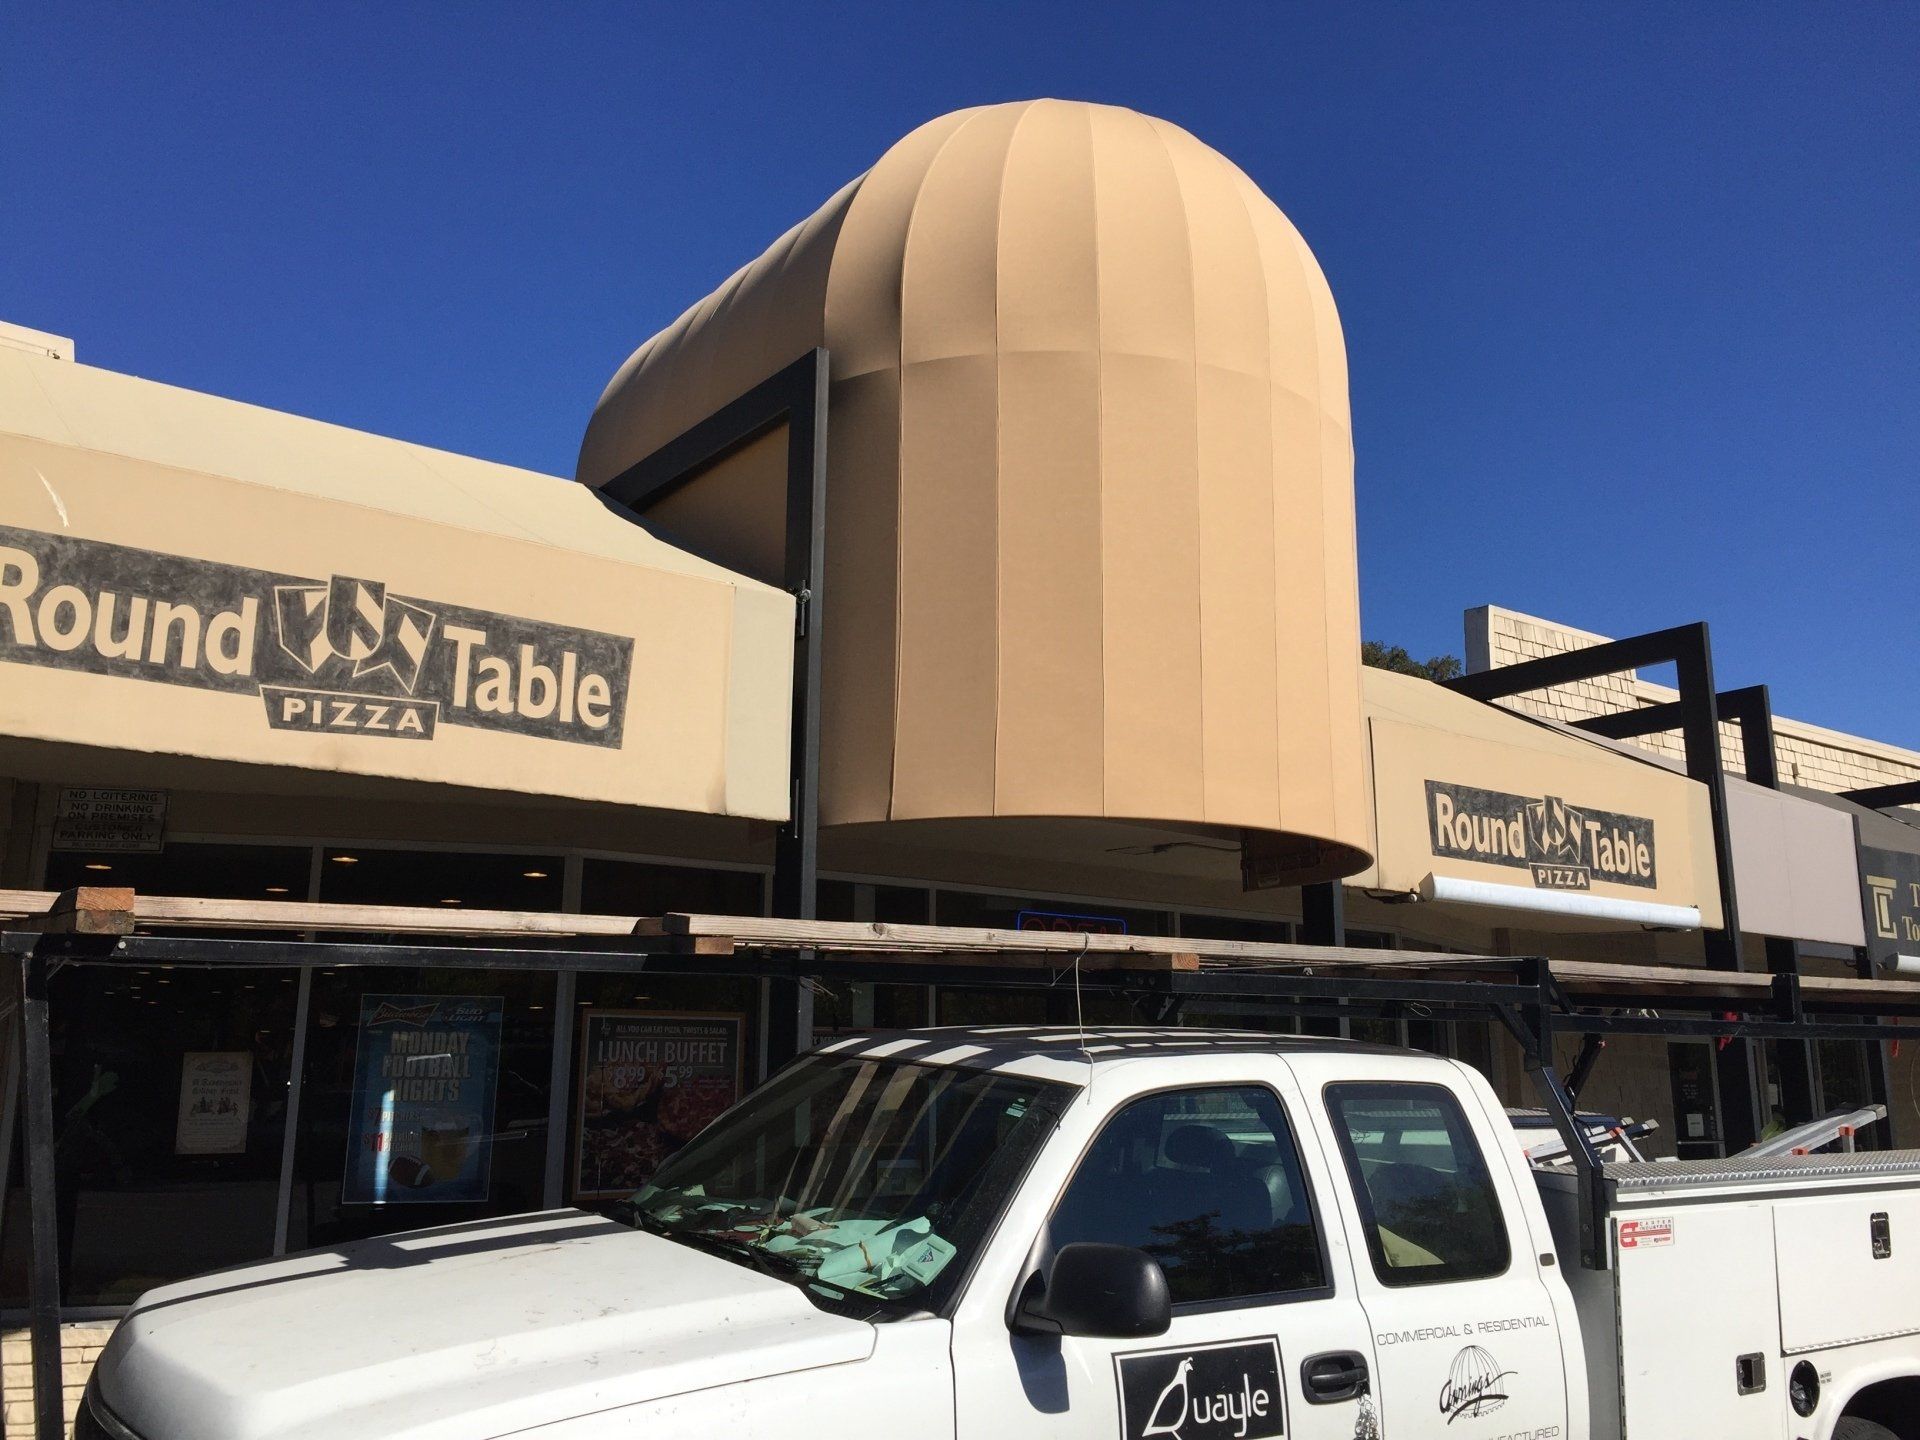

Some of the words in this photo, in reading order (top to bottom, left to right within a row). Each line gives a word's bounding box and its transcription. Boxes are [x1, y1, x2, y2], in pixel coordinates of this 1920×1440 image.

[0, 546, 258, 676] Round
[444, 624, 611, 729] Table
[283, 697, 424, 733] PIZZA
[69, 790, 87, 799] NO
[93, 791, 158, 802] LOITERING
[68, 811, 86, 820] ON
[91, 812, 155, 822] PREMISES
[71, 802, 89, 810] NO
[95, 803, 153, 814] DRINKING
[60, 831, 115, 840] PARKING
[121, 831, 154, 841] ONLY
[1436, 793, 1526, 859] Round
[1585, 821, 1651, 877] Table
[1538, 868, 1587, 887] PIZZA
[1901, 915, 1920, 942] To
[391, 1031, 470, 1054] MONDAY
[598, 1040, 658, 1063] LUNCH
[664, 1041, 728, 1063] BUFFET
[382, 1054, 471, 1079] FOOTBALL
[391, 1078, 460, 1102] NIGHTS
[1377, 1325, 1461, 1347] COMMERCIAL
[1463, 1323, 1474, 1335] &
[1478, 1316, 1550, 1334] RESIDENTIAL
